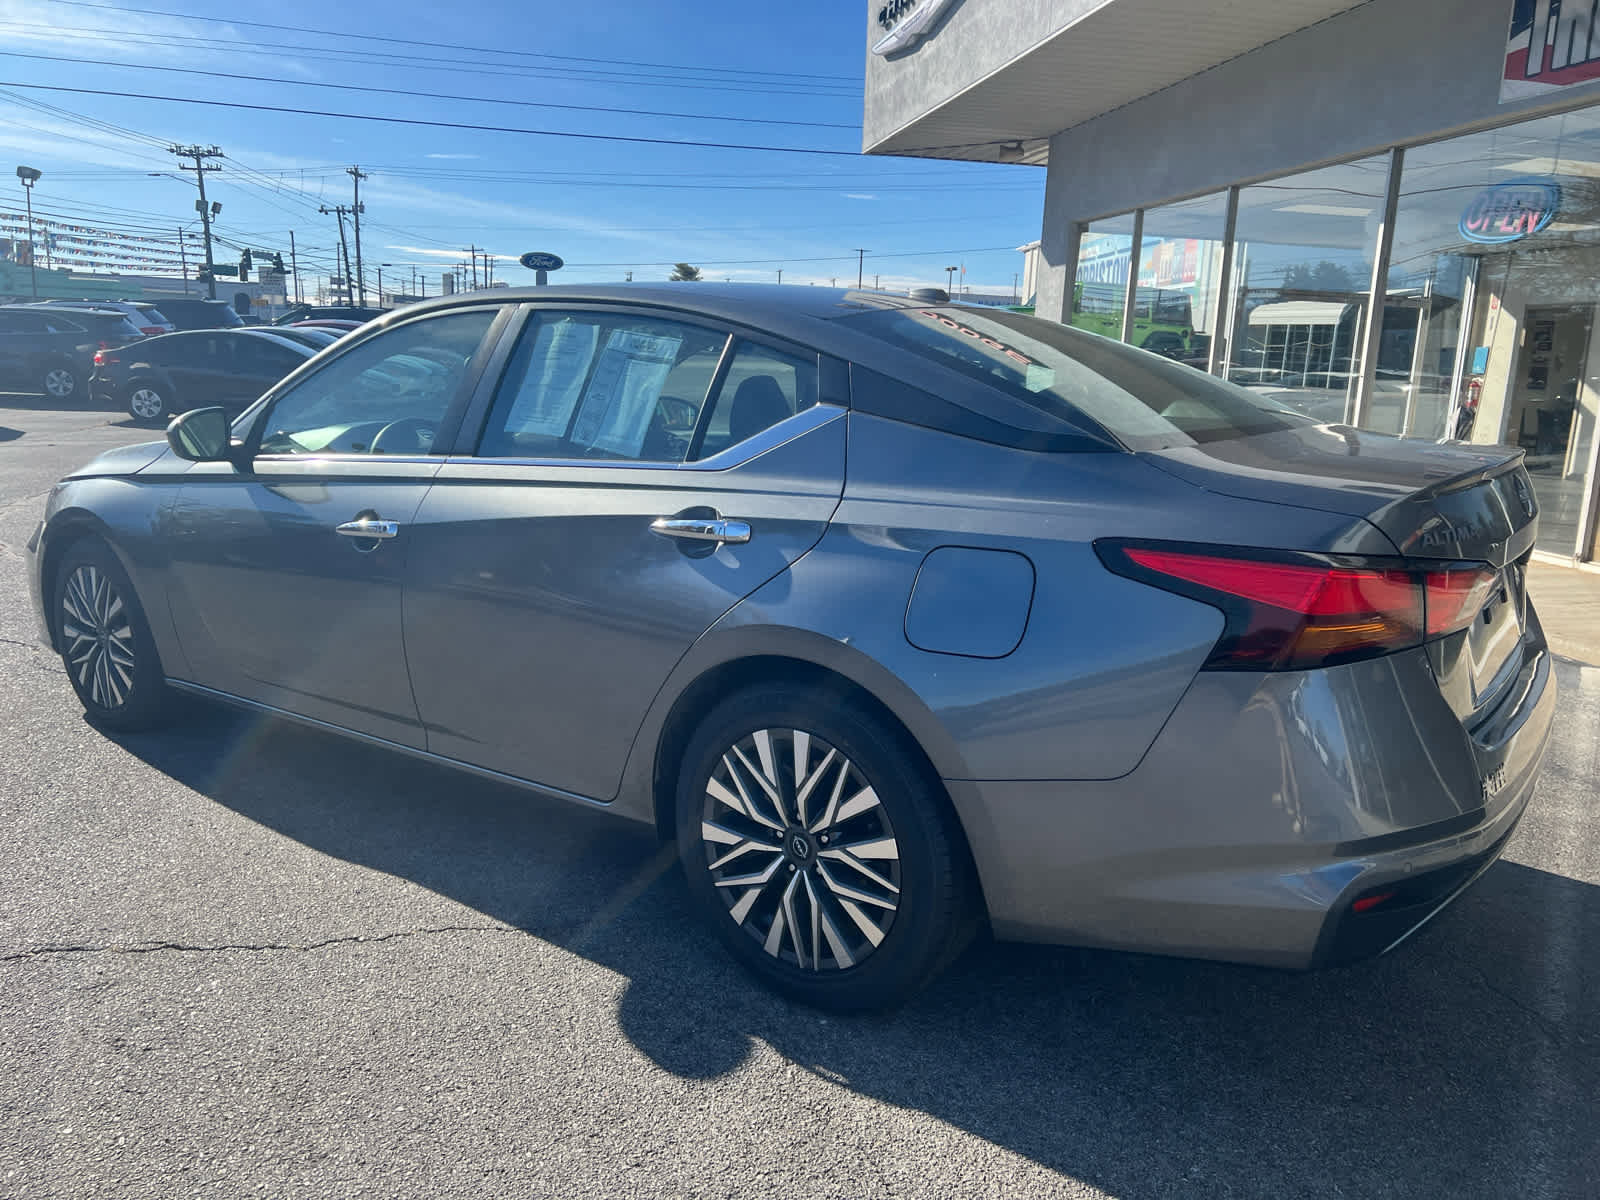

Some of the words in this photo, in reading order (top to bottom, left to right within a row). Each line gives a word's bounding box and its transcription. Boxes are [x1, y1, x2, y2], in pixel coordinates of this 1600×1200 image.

[1466, 190, 1545, 233] OPEN
[528, 256, 554, 268] Ford
[1424, 527, 1480, 546] ALTIMA
